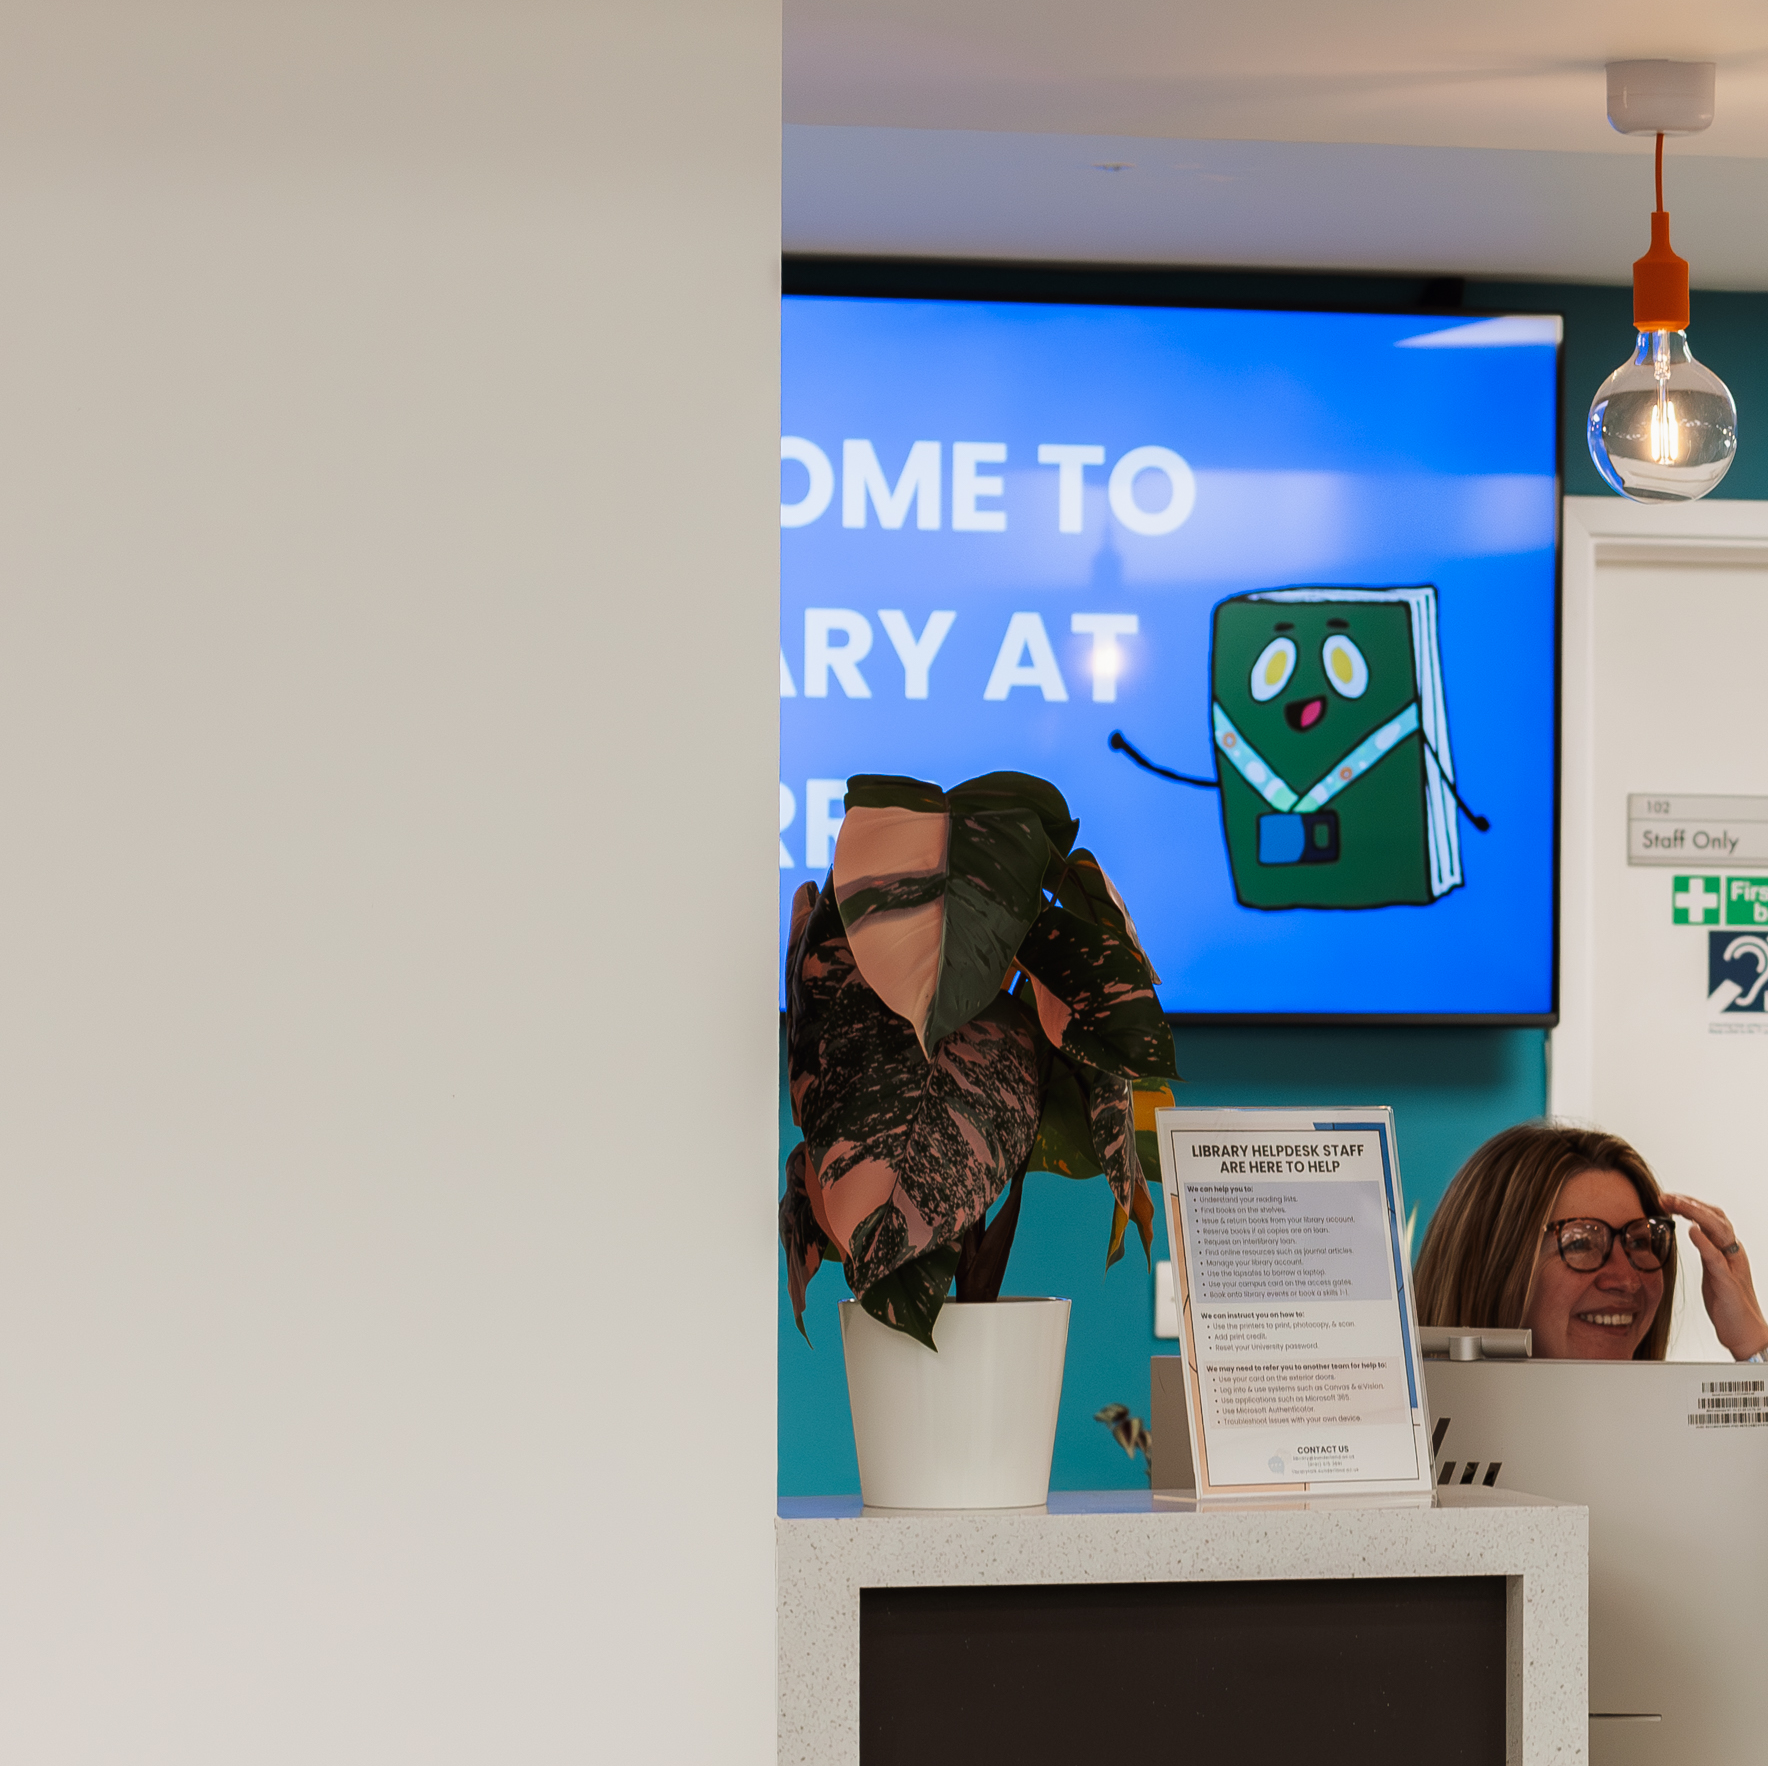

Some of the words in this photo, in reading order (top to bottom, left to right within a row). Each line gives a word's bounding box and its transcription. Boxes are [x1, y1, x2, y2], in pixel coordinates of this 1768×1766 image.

[1037, 444, 1198, 536] TO
[983, 611, 1139, 704] AT
[1642, 828, 1686, 849] Staff
[1692, 829, 1739, 855] Only
[1191, 1145, 1248, 1157] LIBRARY
[1251, 1144, 1320, 1157] HELPDESK
[1323, 1144, 1364, 1157] STAFF
[1220, 1161, 1246, 1173] ARE
[1249, 1161, 1283, 1173] HERE
[1286, 1160, 1305, 1173] TO
[1308, 1160, 1340, 1173] HELP
[1214, 1185, 1229, 1194] help
[1230, 1186, 1244, 1194] you
[1219, 1366, 1235, 1374] may
[1236, 1364, 1253, 1372] need
[1281, 1365, 1294, 1373] you
[1331, 1362, 1350, 1370] team
[1362, 1362, 1377, 1371] help
[1297, 1445, 1336, 1454] CONTACT
[1338, 1445, 1349, 1453] US
